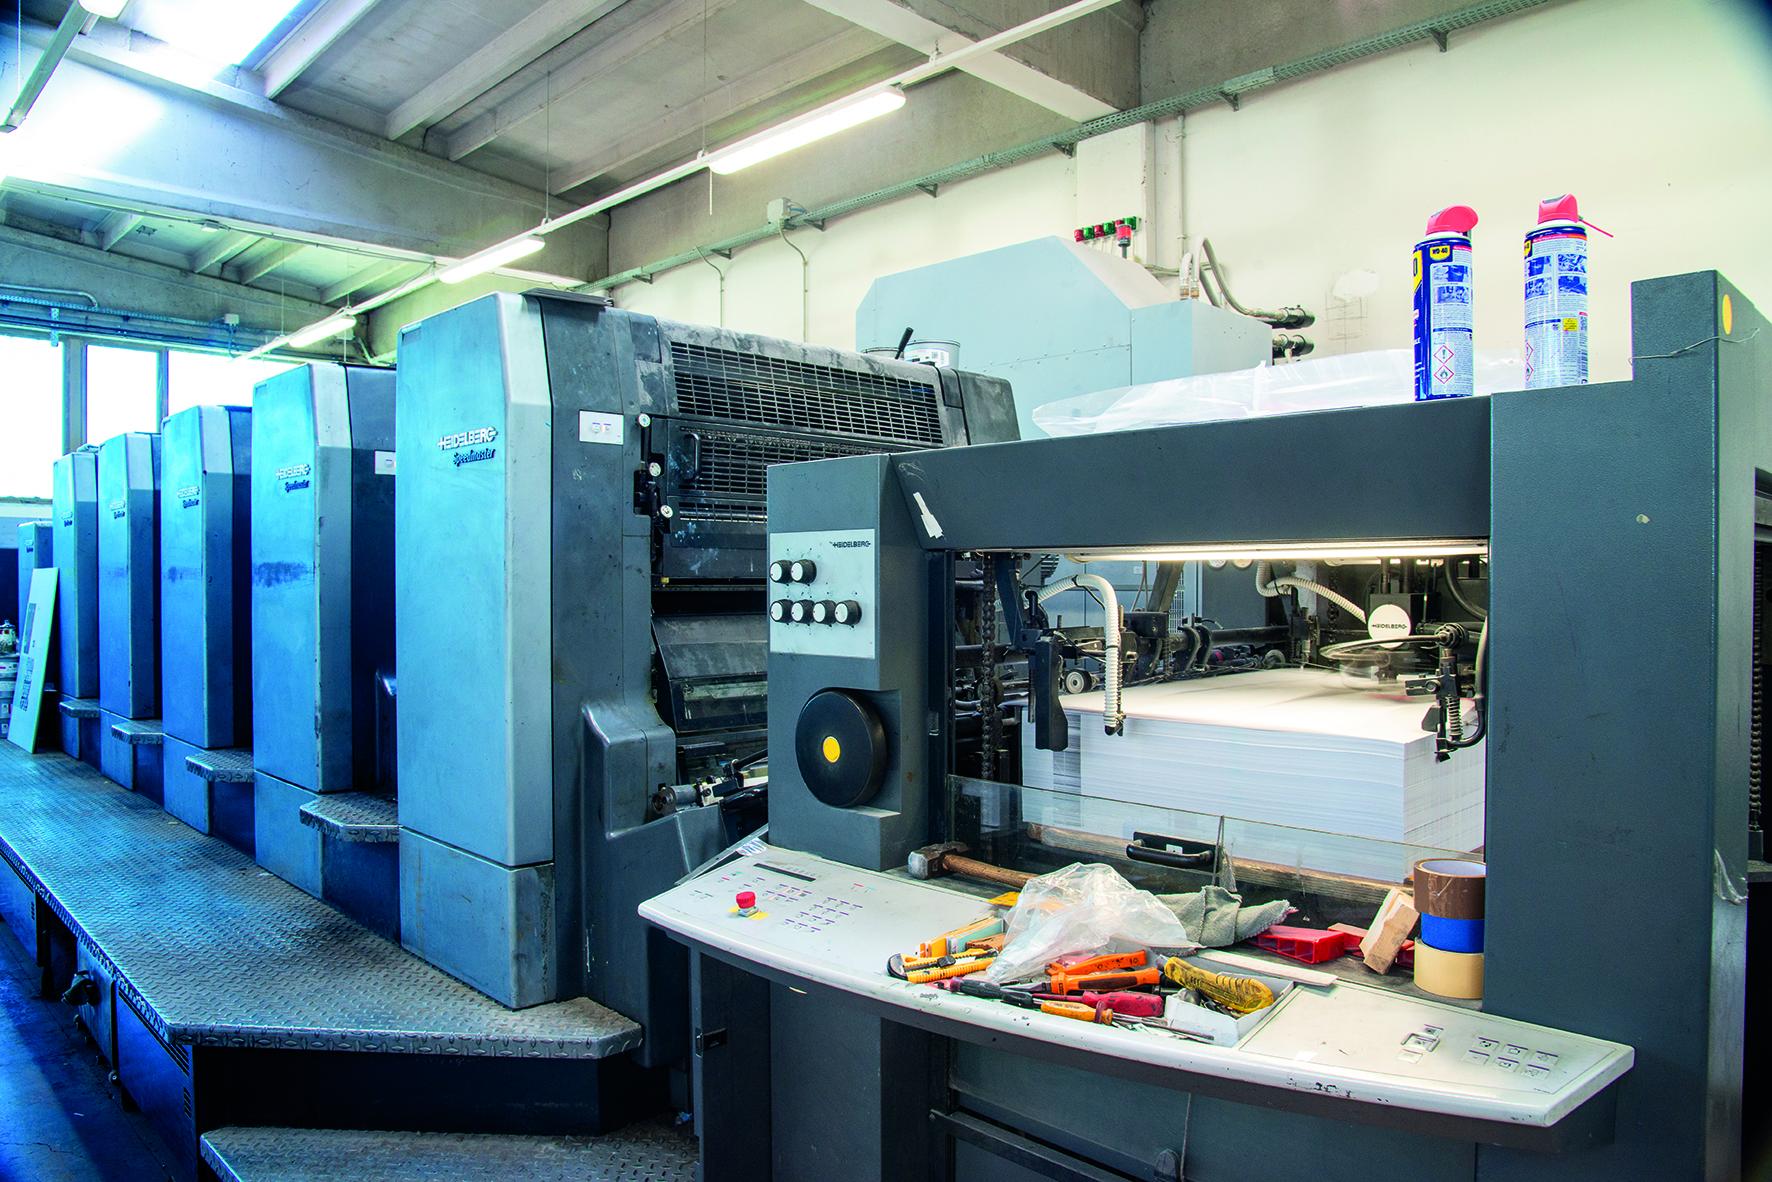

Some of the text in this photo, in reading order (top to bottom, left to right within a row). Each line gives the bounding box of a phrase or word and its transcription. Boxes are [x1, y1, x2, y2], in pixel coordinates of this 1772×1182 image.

[438, 426, 498, 450] HEIDELBERG
[453, 448, 496, 467] Speedmaster
[832, 540, 871, 548] HEIDELBERG
